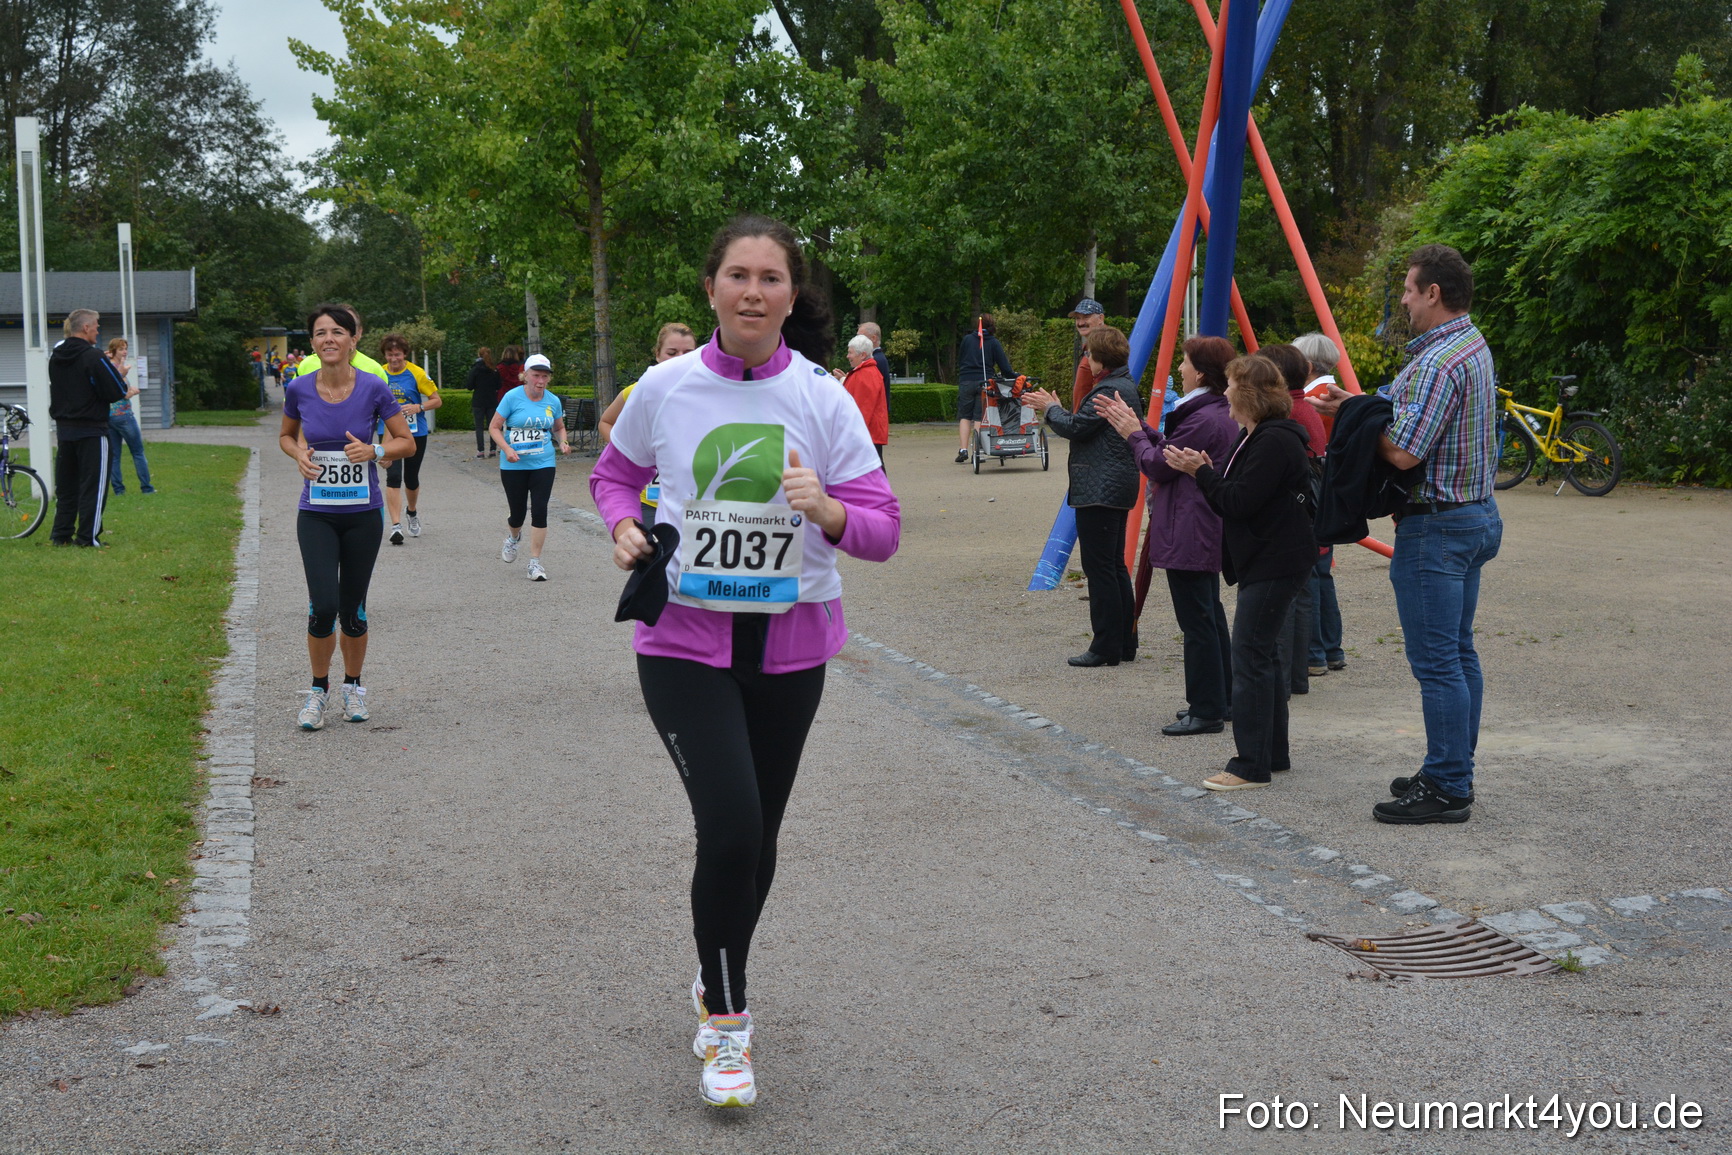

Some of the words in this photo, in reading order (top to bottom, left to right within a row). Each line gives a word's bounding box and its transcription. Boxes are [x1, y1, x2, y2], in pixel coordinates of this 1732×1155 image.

[513, 430, 541, 442] 2142
[316, 463, 363, 484] 2588
[321, 489, 358, 498] Germaine
[685, 510, 725, 522] PARTL
[728, 513, 786, 526] Neumarkt
[694, 527, 794, 571] 2037
[707, 580, 771, 598] Melanie
